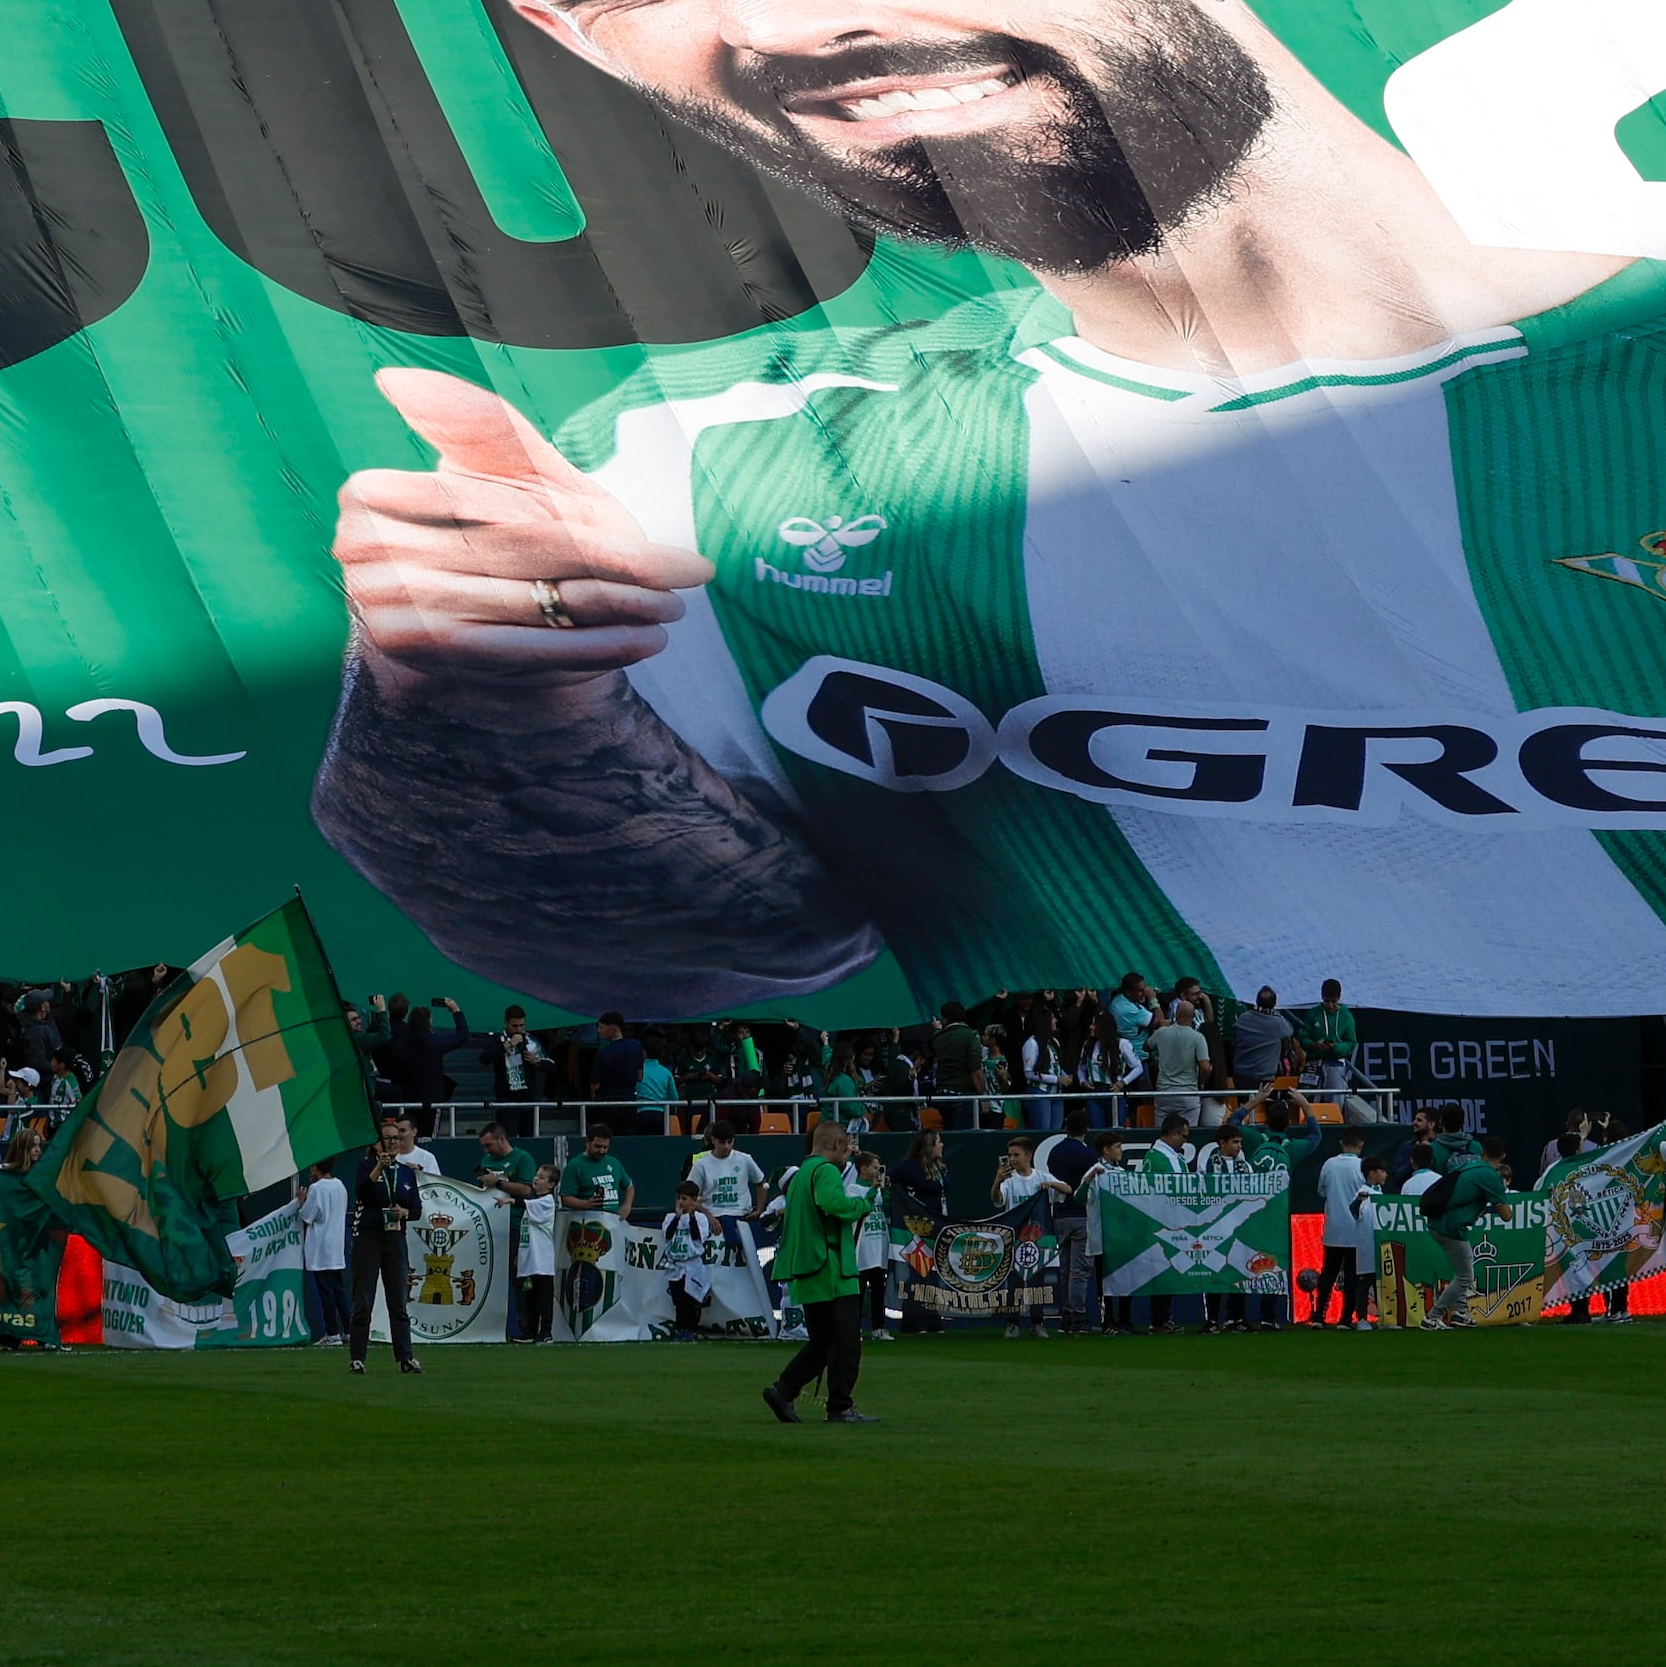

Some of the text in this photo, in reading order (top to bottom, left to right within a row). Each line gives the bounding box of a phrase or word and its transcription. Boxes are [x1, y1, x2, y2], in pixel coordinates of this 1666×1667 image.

[754, 555, 893, 598] hummel
[1429, 1038, 1557, 1080] GREEN
[1213, 1171, 1283, 1195] TENERIFE
[1169, 1196, 1222, 1206] DESDE 2020
[1592, 1231, 1632, 1249] 1975-2025
[104, 1277, 150, 1308] NTONIO
[1506, 1296, 1532, 1319] 2017
[103, 1308, 145, 1335] OGUER
[408, 1317, 465, 1335] OSUNA
